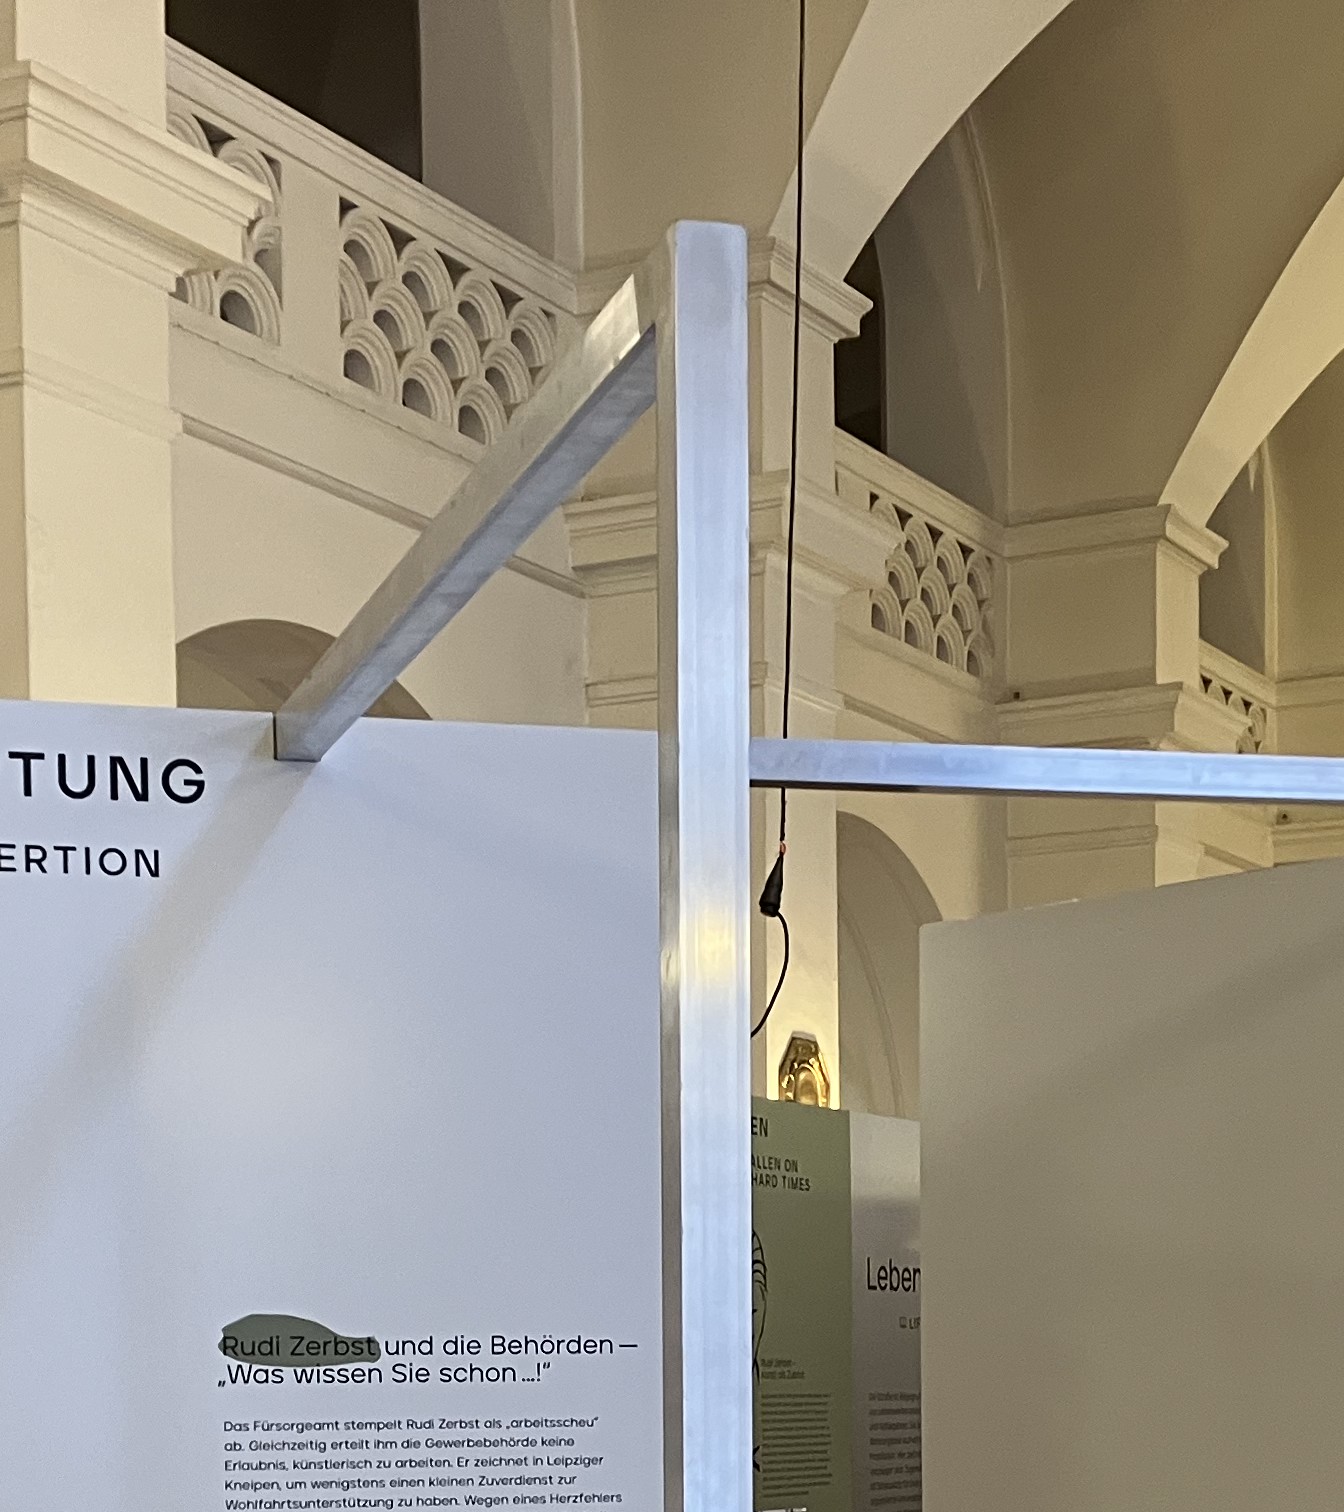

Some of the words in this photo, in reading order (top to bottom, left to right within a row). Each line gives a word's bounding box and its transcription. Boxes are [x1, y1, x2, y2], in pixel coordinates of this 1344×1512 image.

[784, 1158, 799, 1173] ON
[782, 1175, 811, 1191] TIMES
[222, 1335, 280, 1356] Rudi
[289, 1335, 376, 1356] Zerbst
[384, 1335, 433, 1356] und
[442, 1334, 481, 1356] die
[491, 1334, 614, 1356] Behörden
[293, 1363, 383, 1384] wissen
[392, 1362, 431, 1383] Sie
[439, 1363, 517, 1383] schon
[223, 1421, 250, 1432] Das
[344, 1419, 403, 1433] stempelt
[406, 1418, 435, 1430] Rudi
[438, 1418, 480, 1430] Zerbst
[483, 1418, 503, 1429] als
[330, 1438, 370, 1451] erteilt
[373, 1439, 398, 1450] ihm
[400, 1438, 421, 1450] die
[541, 1436, 575, 1447] keine
[376, 1460, 392, 1469] zu
[457, 1456, 470, 1468] Er
[474, 1456, 529, 1468] zeichnet
[532, 1455, 544, 1466] in
[546, 1454, 604, 1469] Leipziger
[286, 1481, 307, 1490] um
[310, 1477, 386, 1492] wenigstens
[389, 1477, 425, 1488] einen
[428, 1476, 475, 1487] kleinen
[557, 1476, 577, 1485] zur
[397, 1498, 413, 1507] zu
[464, 1494, 509, 1508] Wegen
[512, 1493, 547, 1505] eines
